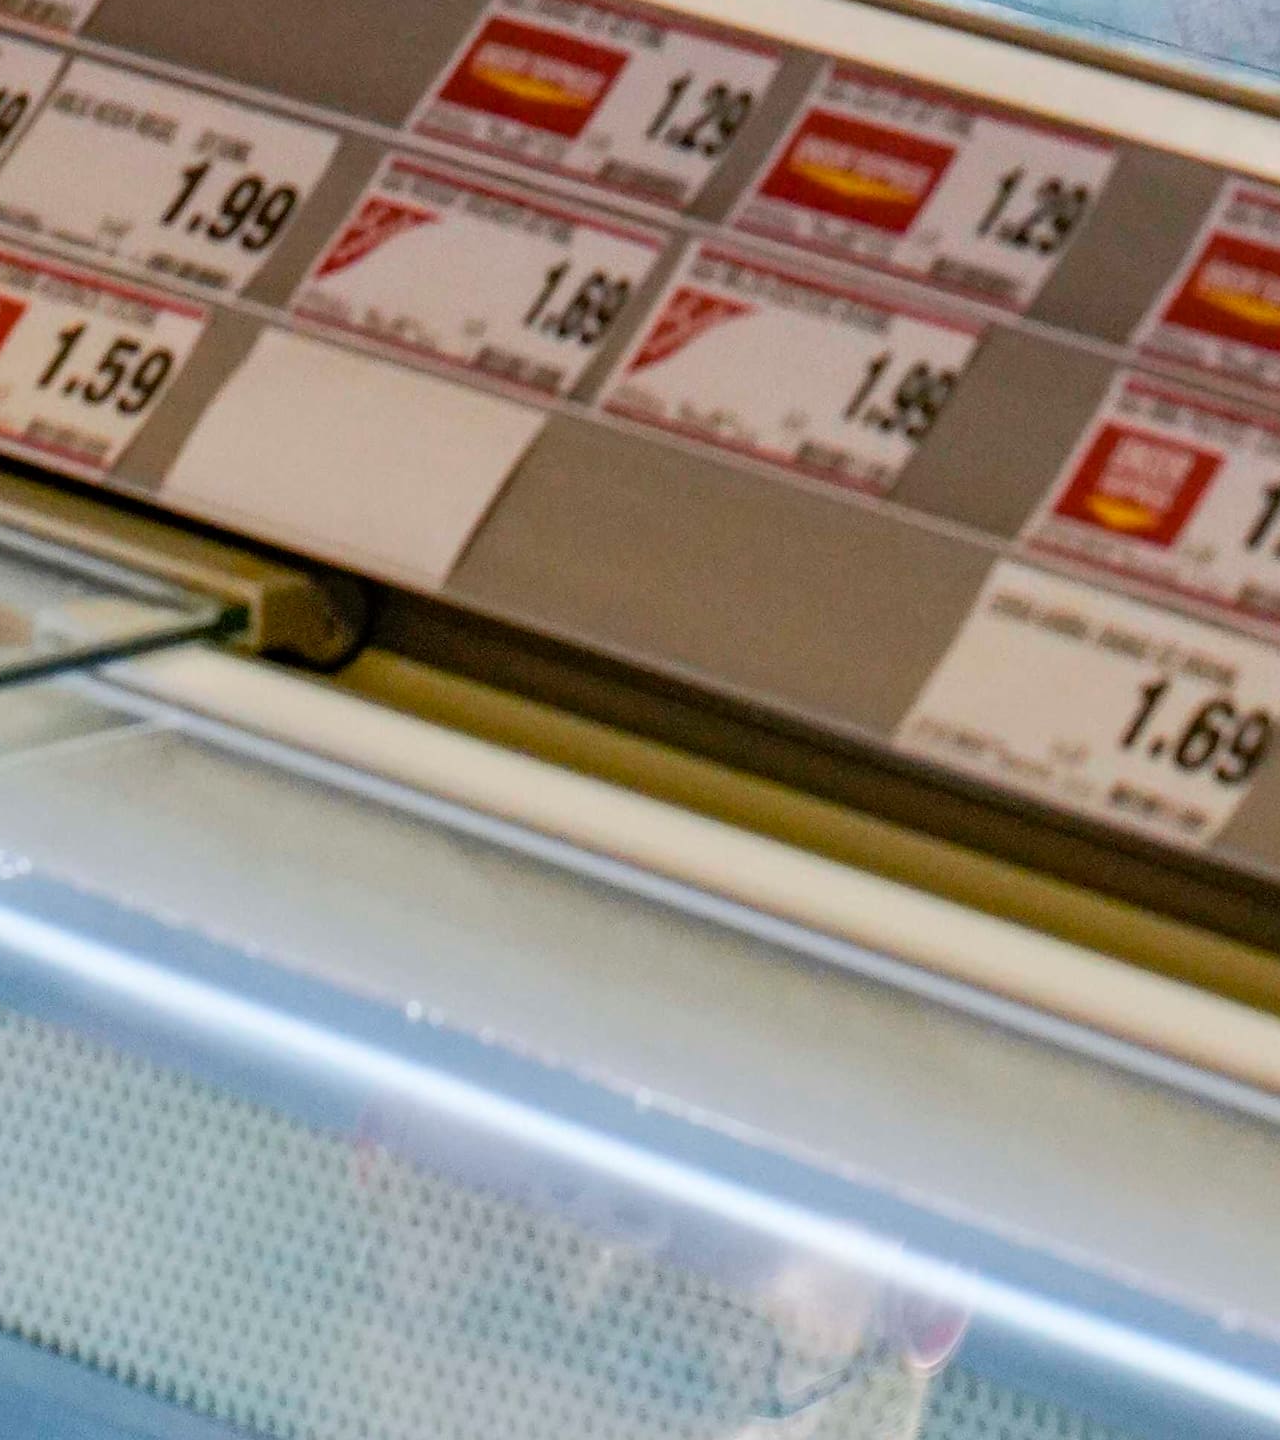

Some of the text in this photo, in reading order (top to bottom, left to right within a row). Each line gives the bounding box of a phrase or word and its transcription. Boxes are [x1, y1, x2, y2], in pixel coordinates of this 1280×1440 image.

[644, 68, 754, 157] 1.29
[160, 160, 298, 255] 1.99
[976, 165, 1093, 258] 1.29
[36, 318, 175, 414] 1.59
[844, 350, 959, 441] 1.99
[1118, 678, 1276, 786] 1.69
